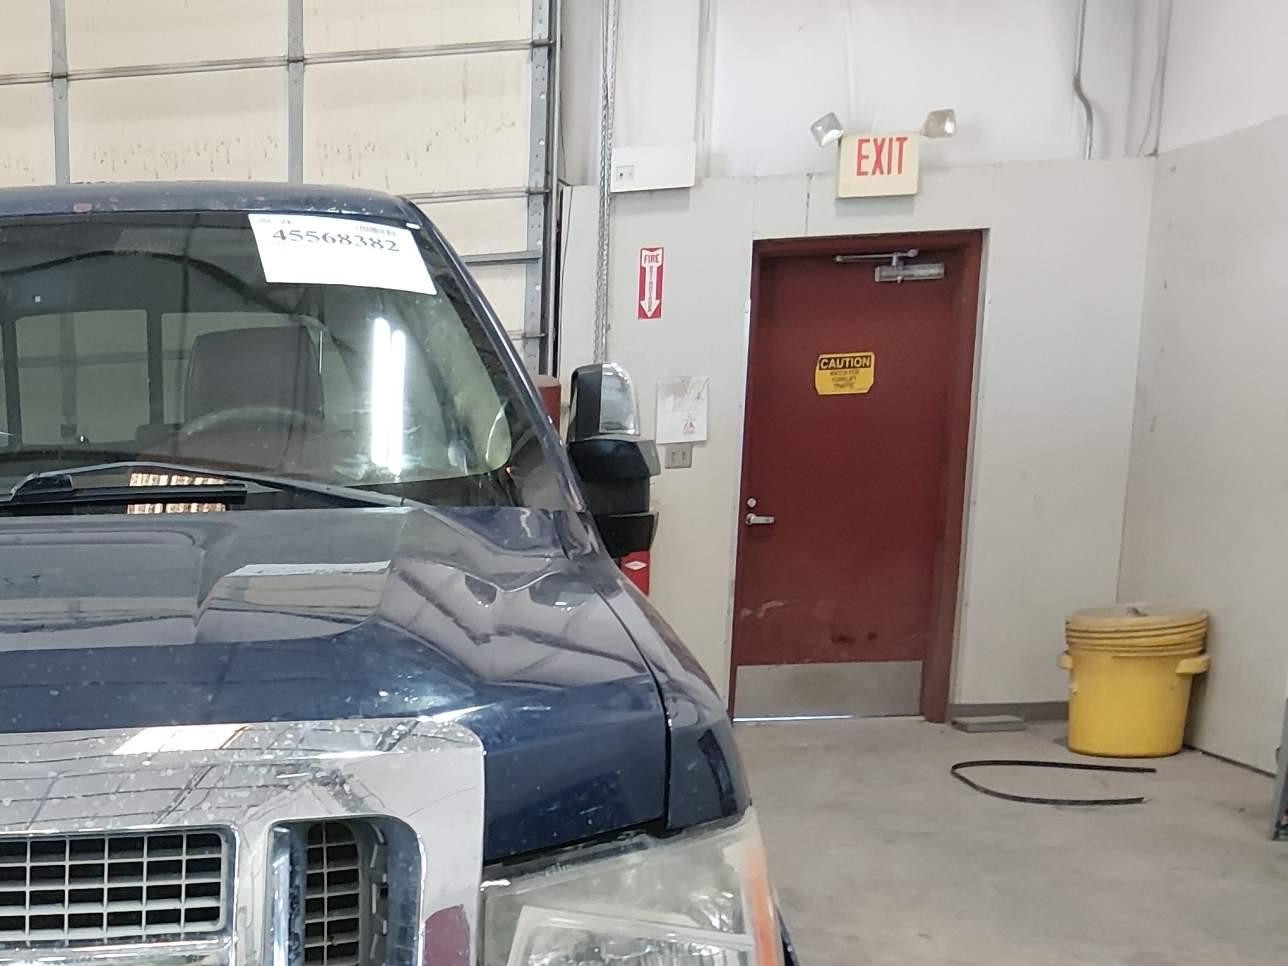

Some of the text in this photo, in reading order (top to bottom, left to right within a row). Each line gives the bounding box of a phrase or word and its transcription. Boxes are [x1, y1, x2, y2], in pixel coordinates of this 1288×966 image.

[855, 136, 909, 176] EXIT
[272, 228, 400, 253] 45568382
[643, 253, 661, 265] FIRE
[820, 356, 871, 370] CAUTION
